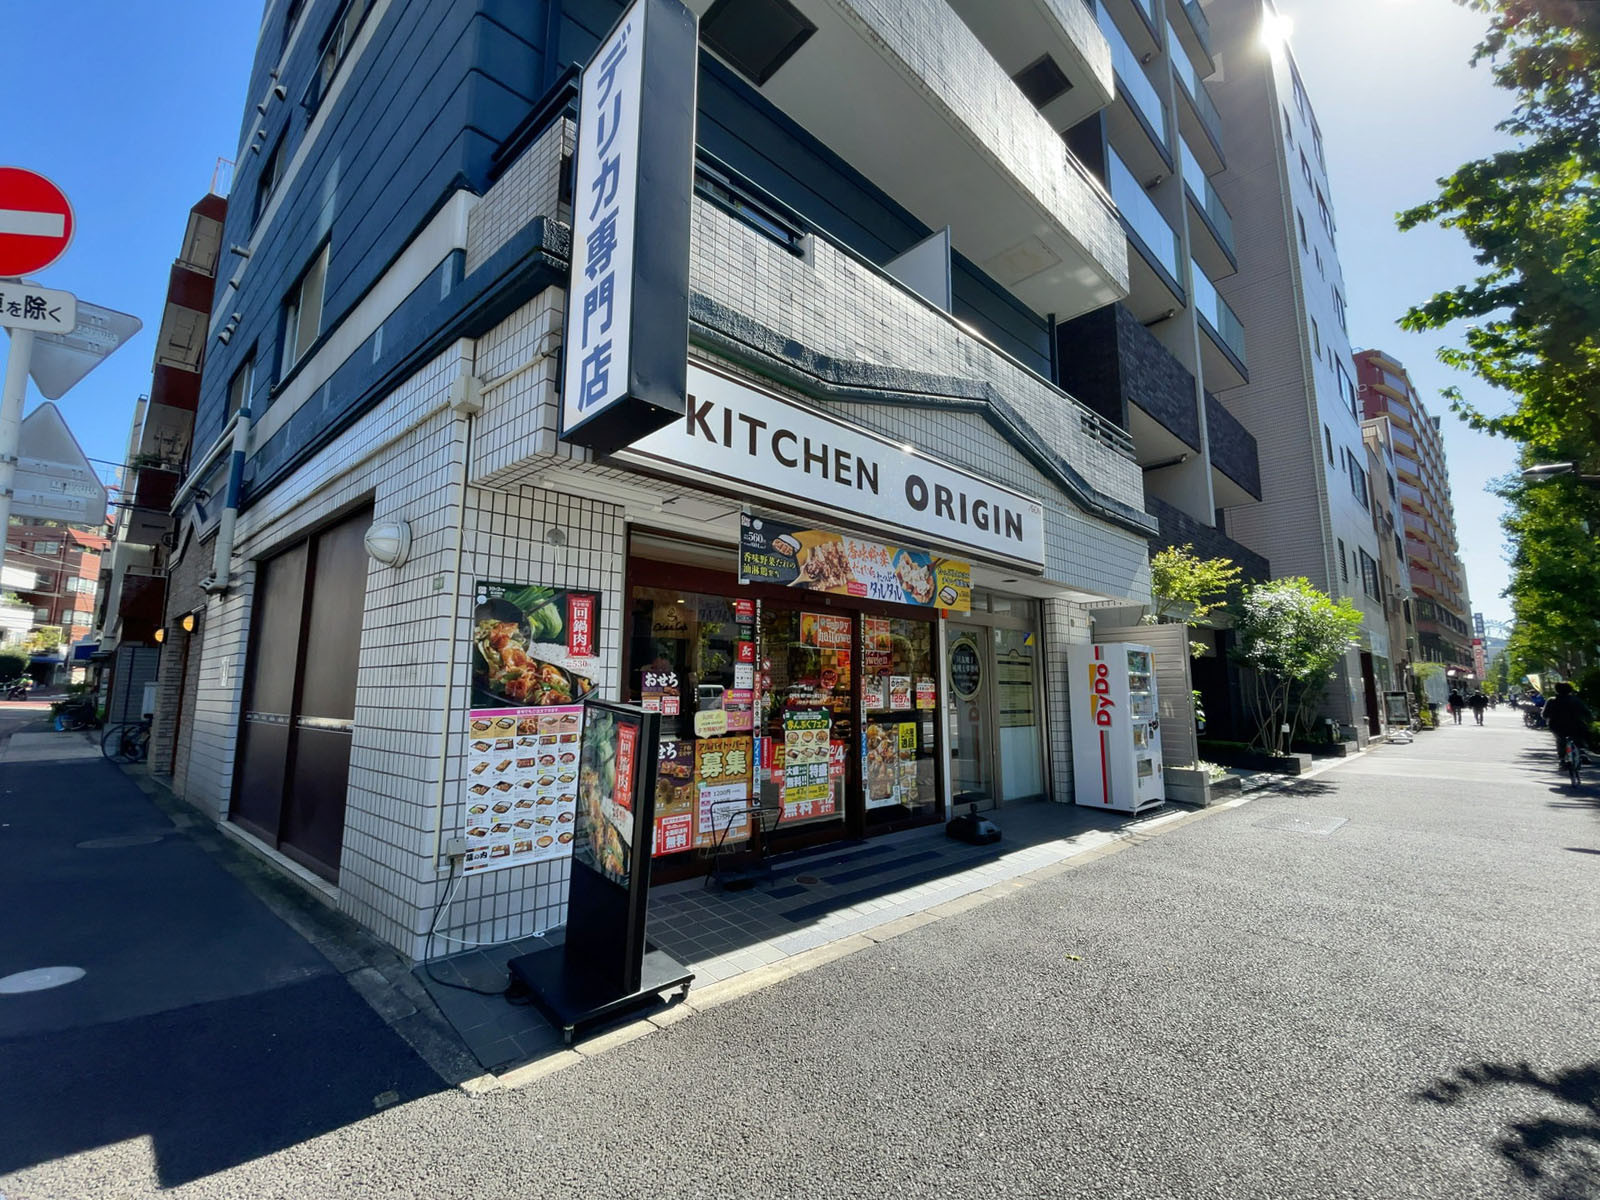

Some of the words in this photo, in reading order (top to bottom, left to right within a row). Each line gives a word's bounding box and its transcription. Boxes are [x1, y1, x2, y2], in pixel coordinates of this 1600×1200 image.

[577, 22, 632, 412] デリカ専門店
[0, 292, 62, 322] を除く
[686, 393, 879, 495] KITCHEN
[904, 473, 1024, 542] ORIGIN
[644, 671, 679, 688] おせち
[1095, 663, 1115, 727] DyDo
[701, 750, 746, 778] 募集
